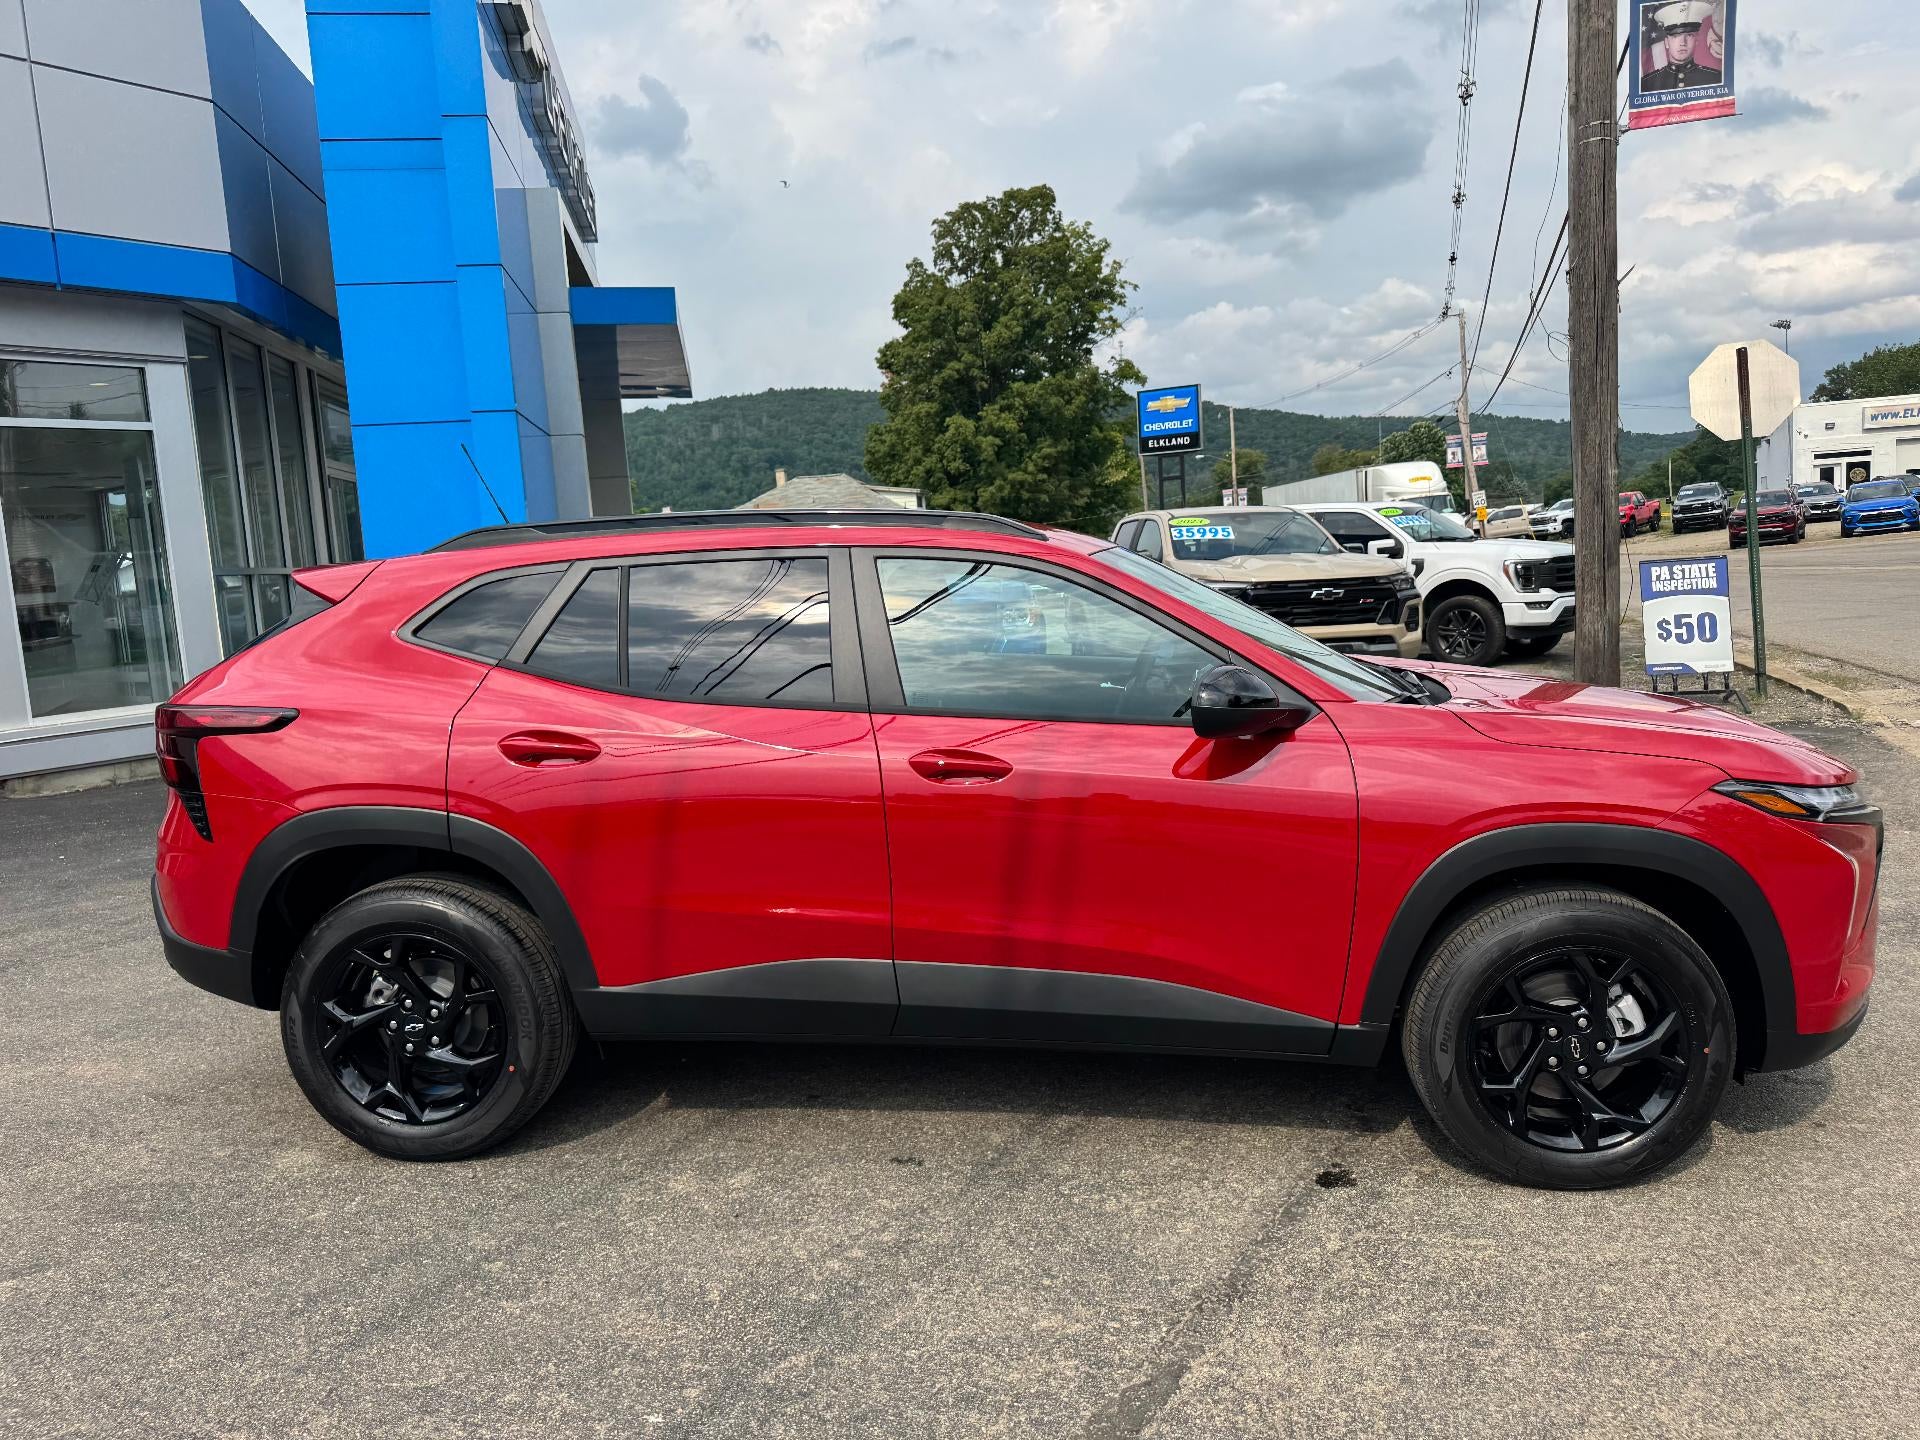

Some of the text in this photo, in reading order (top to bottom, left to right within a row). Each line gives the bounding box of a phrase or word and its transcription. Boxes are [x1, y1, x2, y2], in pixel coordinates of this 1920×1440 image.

[1634, 96, 1660, 105] GLOBAL
[1661, 93, 1676, 102] WAR
[1676, 92, 1686, 100] ON
[1144, 418, 1193, 432] CHEVROLET
[1148, 436, 1190, 448] ELKLAND
[1474, 498, 1486, 506] 40
[1173, 527, 1231, 539] 35995
[1650, 562, 1717, 581] PA STATE
[1651, 576, 1717, 592] INSPECTION
[1656, 611, 1719, 645] $50
